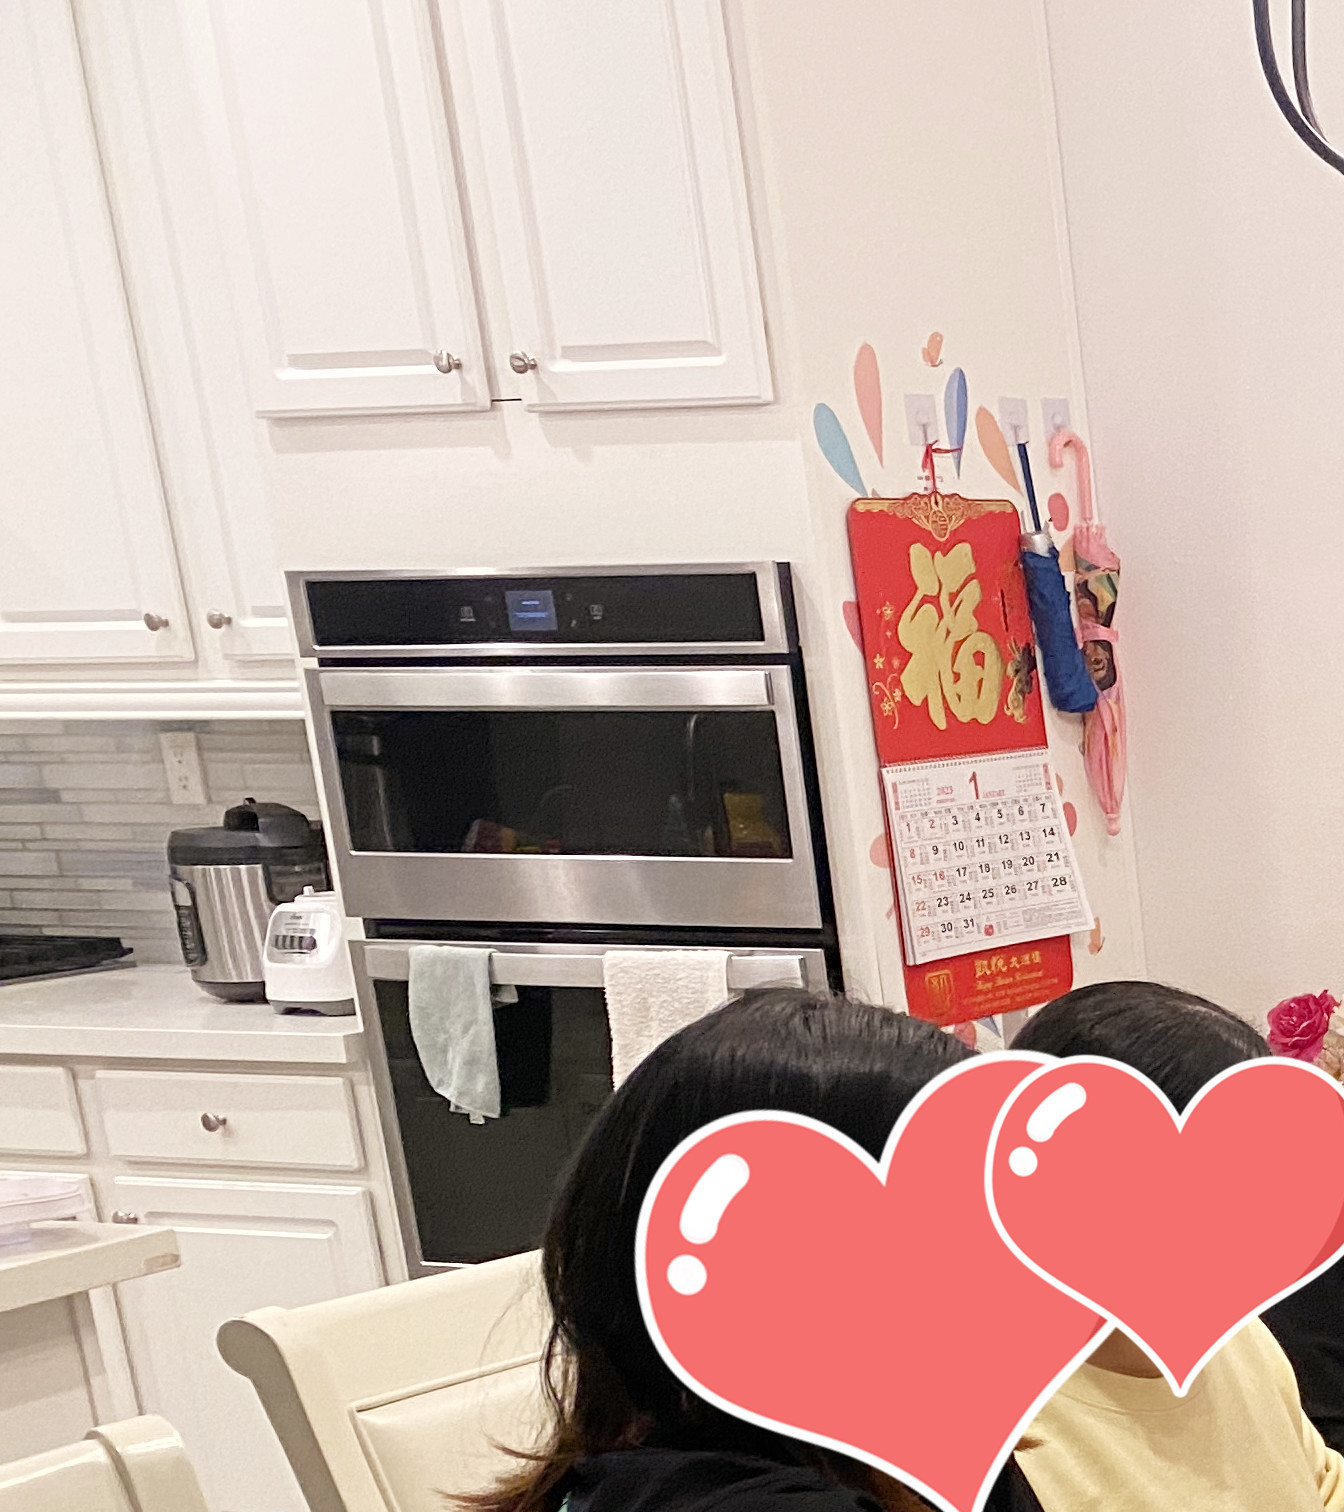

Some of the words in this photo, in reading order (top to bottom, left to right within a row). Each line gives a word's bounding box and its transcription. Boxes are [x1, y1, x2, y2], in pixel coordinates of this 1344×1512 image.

[897, 542, 1000, 731] 福
[968, 771, 980, 800] 1
[928, 819, 936, 829] 2
[951, 815, 959, 826] 3
[974, 812, 981, 822] 4
[997, 810, 1003, 820] 5
[1018, 806, 1025, 816] 6
[1040, 803, 1046, 813] 7
[932, 845, 939, 856] 9
[953, 841, 965, 852] 10
[975, 838, 986, 848] 11
[998, 834, 1010, 845] 12
[1019, 831, 1031, 842] 13
[1042, 827, 1056, 838] 14
[955, 867, 968, 878] 17
[978, 863, 991, 874] 18
[1001, 859, 1013, 870] 19
[1022, 855, 1035, 866] 20
[1046, 852, 1060, 863] 21
[936, 896, 950, 908] 23
[959, 892, 972, 904] 24
[981, 889, 995, 900] 25
[1003, 885, 1017, 896] 26
[1026, 880, 1039, 892] 27
[1051, 876, 1068, 888] 28
[940, 922, 953, 934] 30
[963, 918, 975, 929] 31
